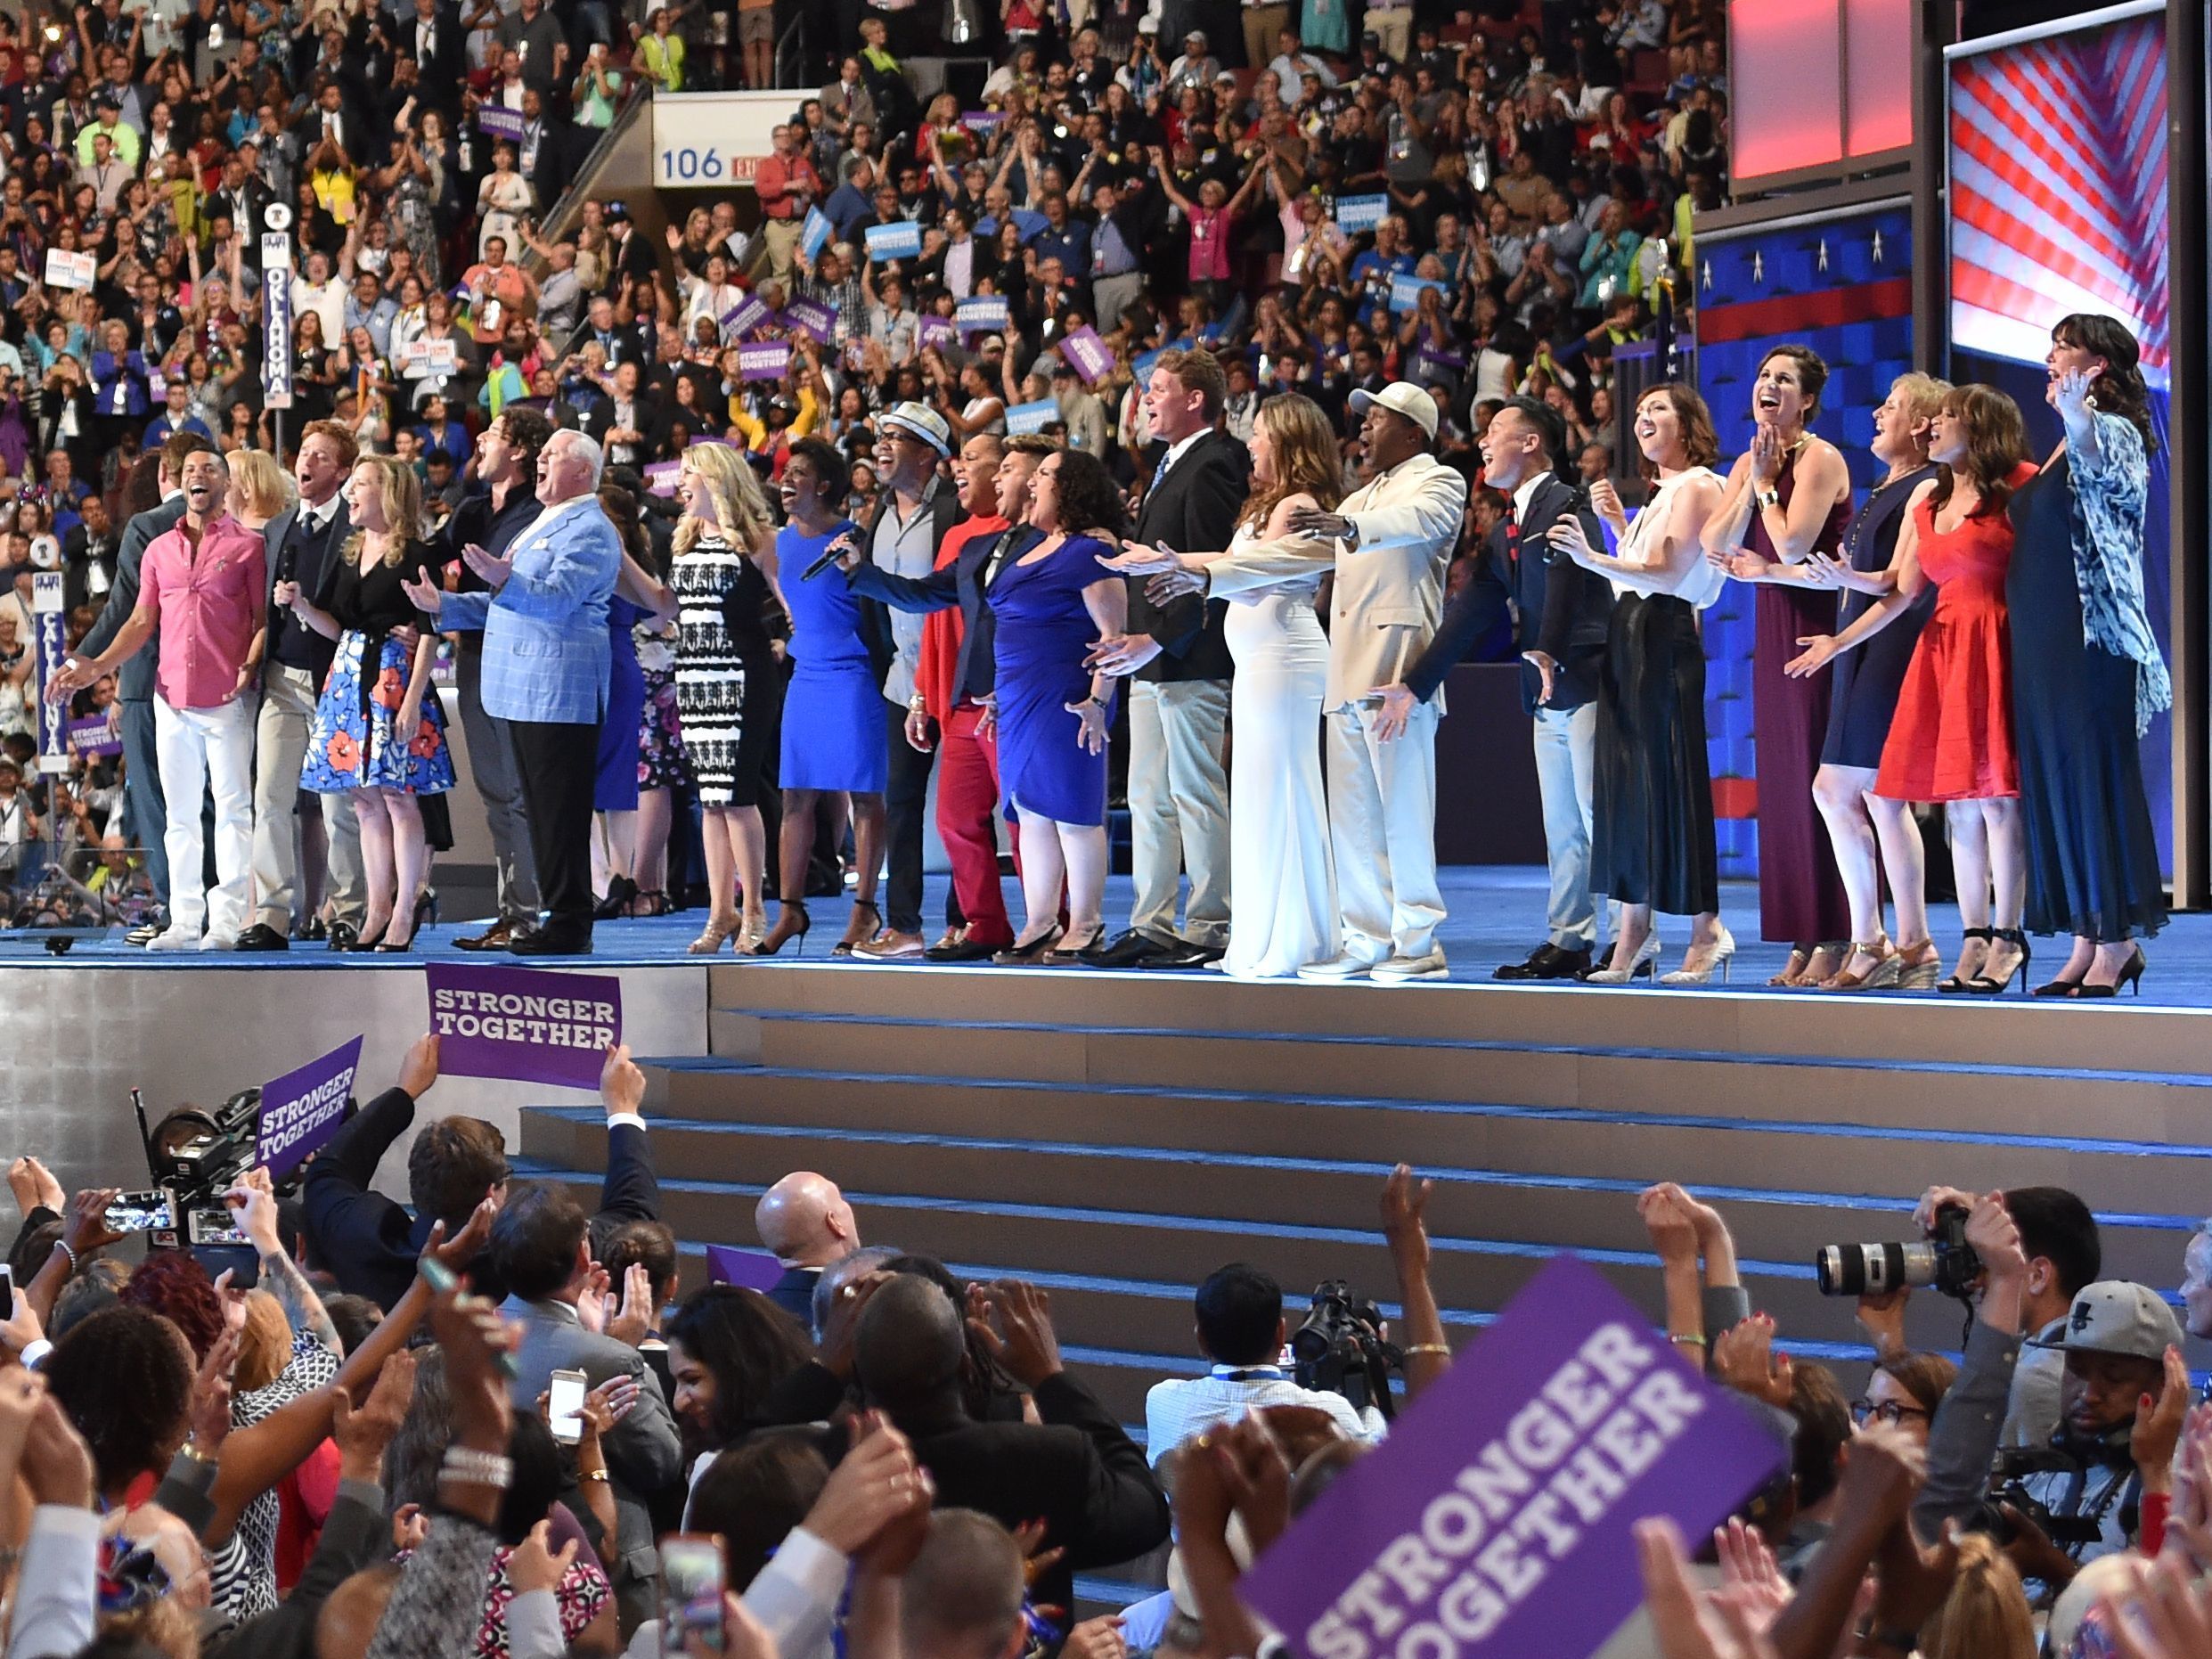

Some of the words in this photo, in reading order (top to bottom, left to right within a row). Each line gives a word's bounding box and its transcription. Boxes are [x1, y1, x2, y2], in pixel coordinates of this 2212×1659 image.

[663, 148, 722, 178] 106
[737, 159, 756, 177] EXI
[268, 268, 287, 393] OKLAHOMA
[739, 348, 788, 361] STRONGER
[435, 989, 615, 1024] STRONGER
[436, 1011, 614, 1050] TOGETHER
[259, 1091, 347, 1161] TOGETHER
[261, 1066, 354, 1136] STRONGER
[1306, 1322, 1655, 1659] STRONGER
[1381, 1369, 1705, 1659] OGETHER
